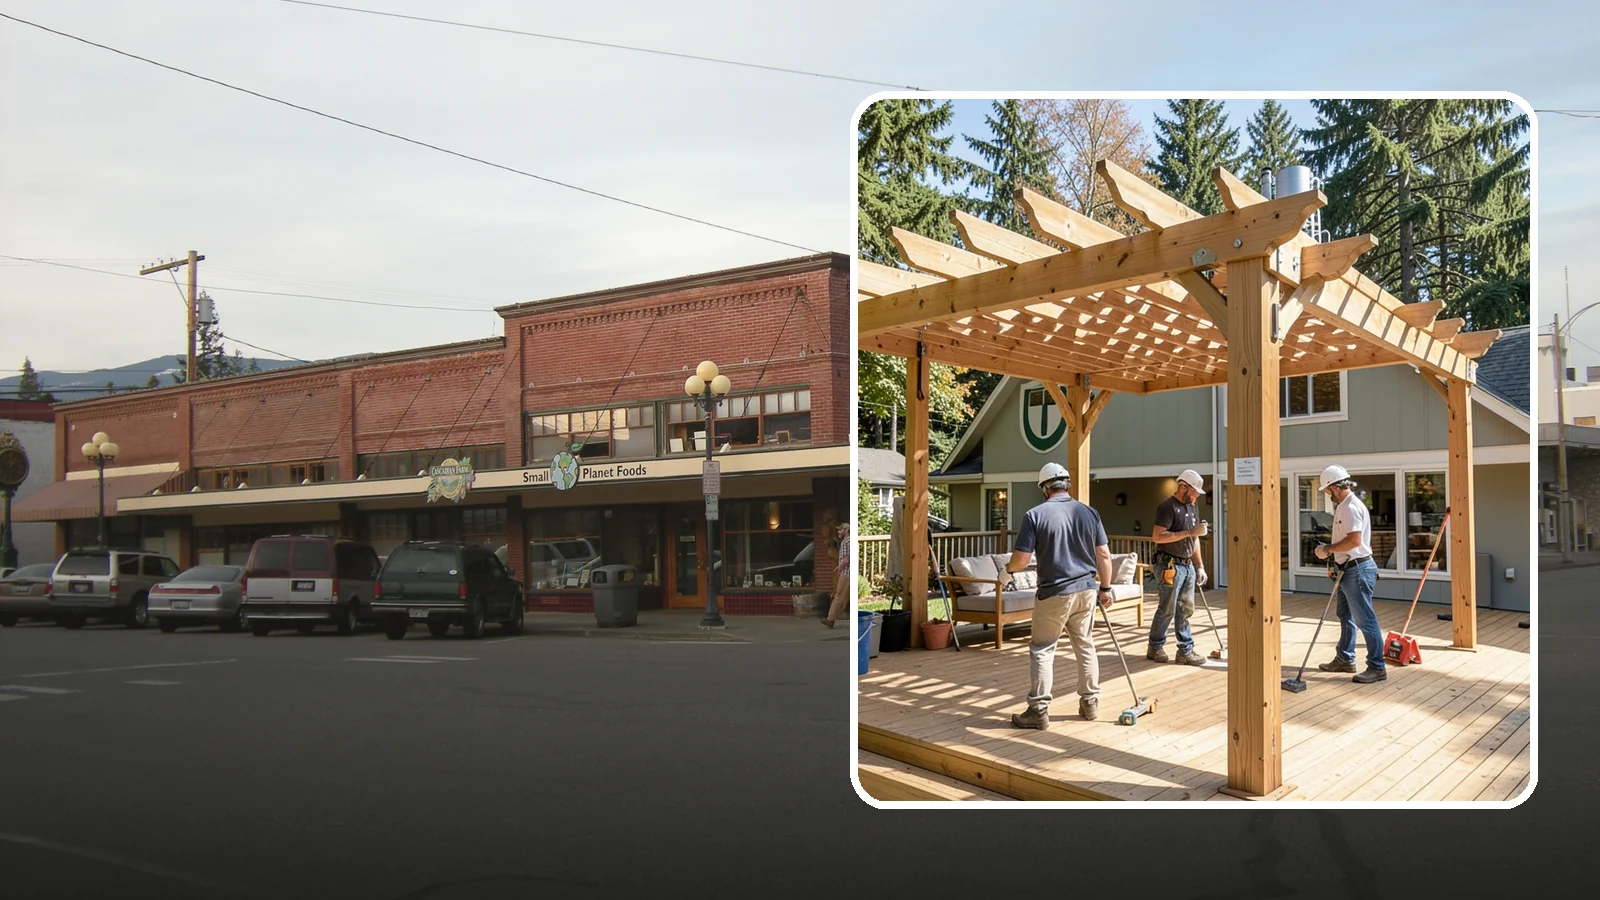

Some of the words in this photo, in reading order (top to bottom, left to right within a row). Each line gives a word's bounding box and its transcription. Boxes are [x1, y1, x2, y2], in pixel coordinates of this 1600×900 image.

[523, 470, 549, 483] Small
[583, 468, 614, 479] Planet
[617, 464, 647, 477] Foods
